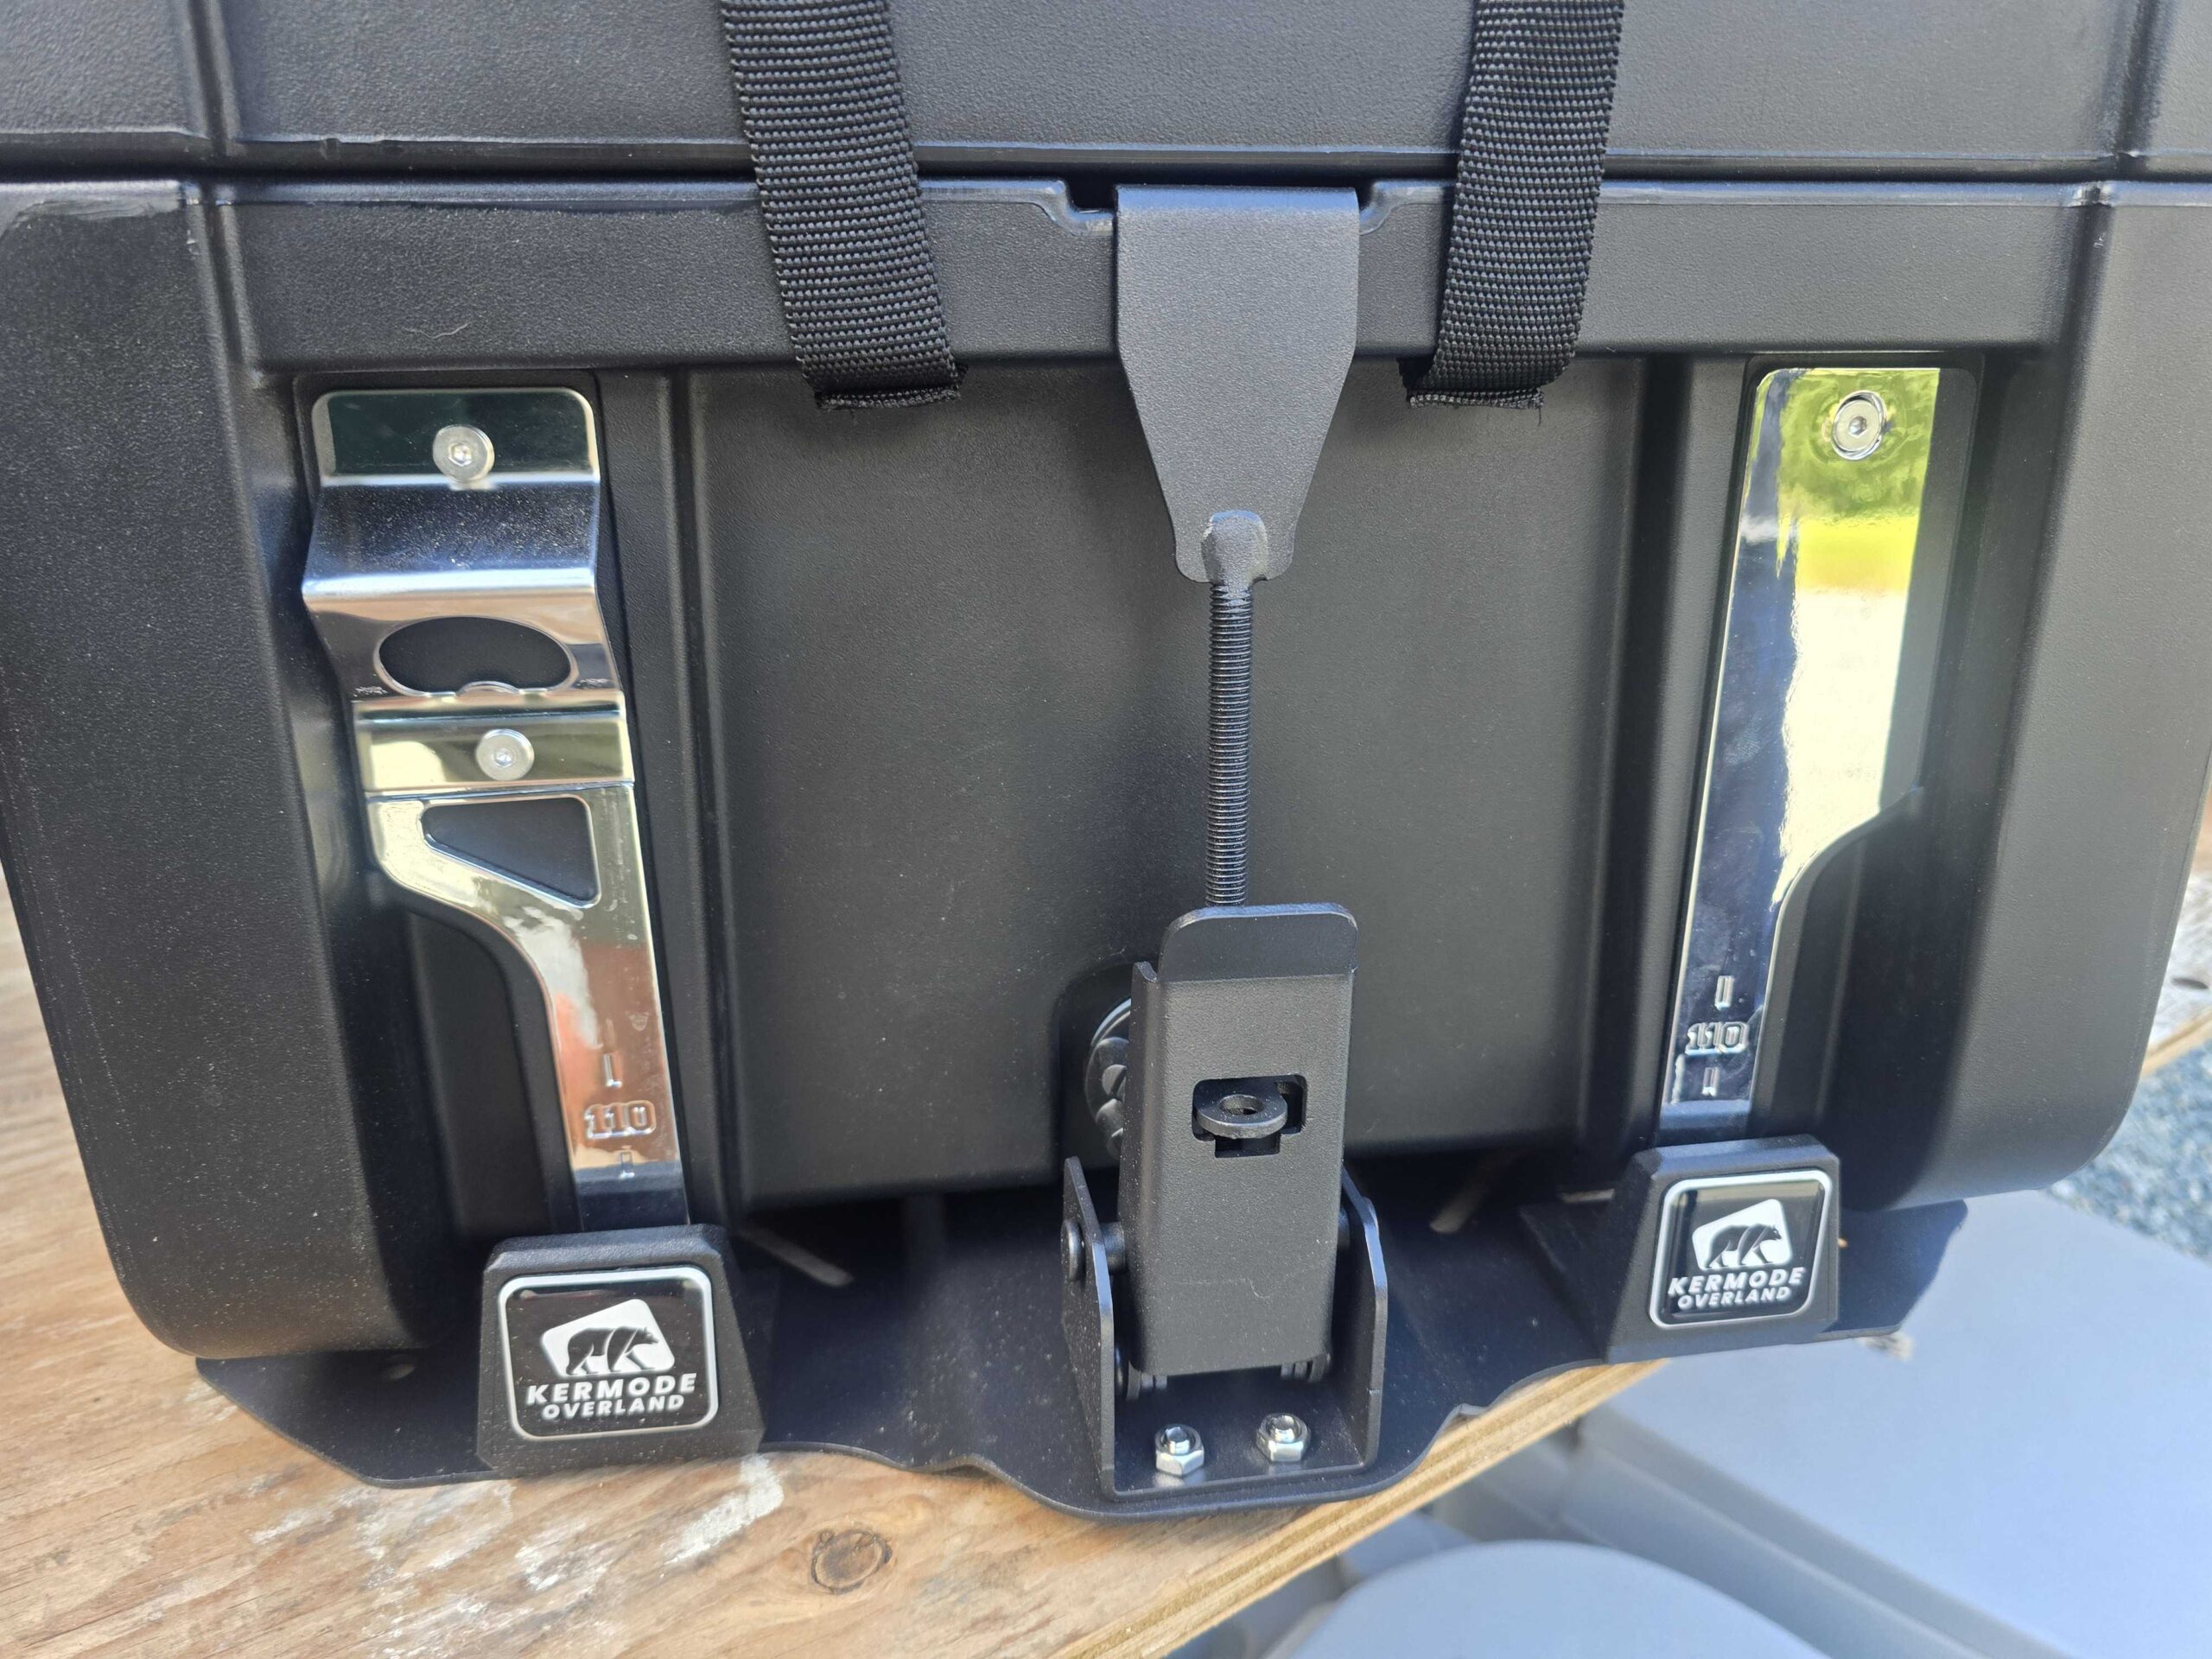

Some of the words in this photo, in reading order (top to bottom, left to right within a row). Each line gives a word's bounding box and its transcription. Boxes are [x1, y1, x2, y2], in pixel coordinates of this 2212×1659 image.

[1685, 1021, 1749, 1055] 110
[584, 1100, 657, 1140] 110
[1668, 1267, 1805, 1296] KERMODE
[1677, 1286, 1792, 1310] OVERLAND
[526, 1372, 697, 1405] KERMODE
[542, 1394, 685, 1420] OVERLAND
